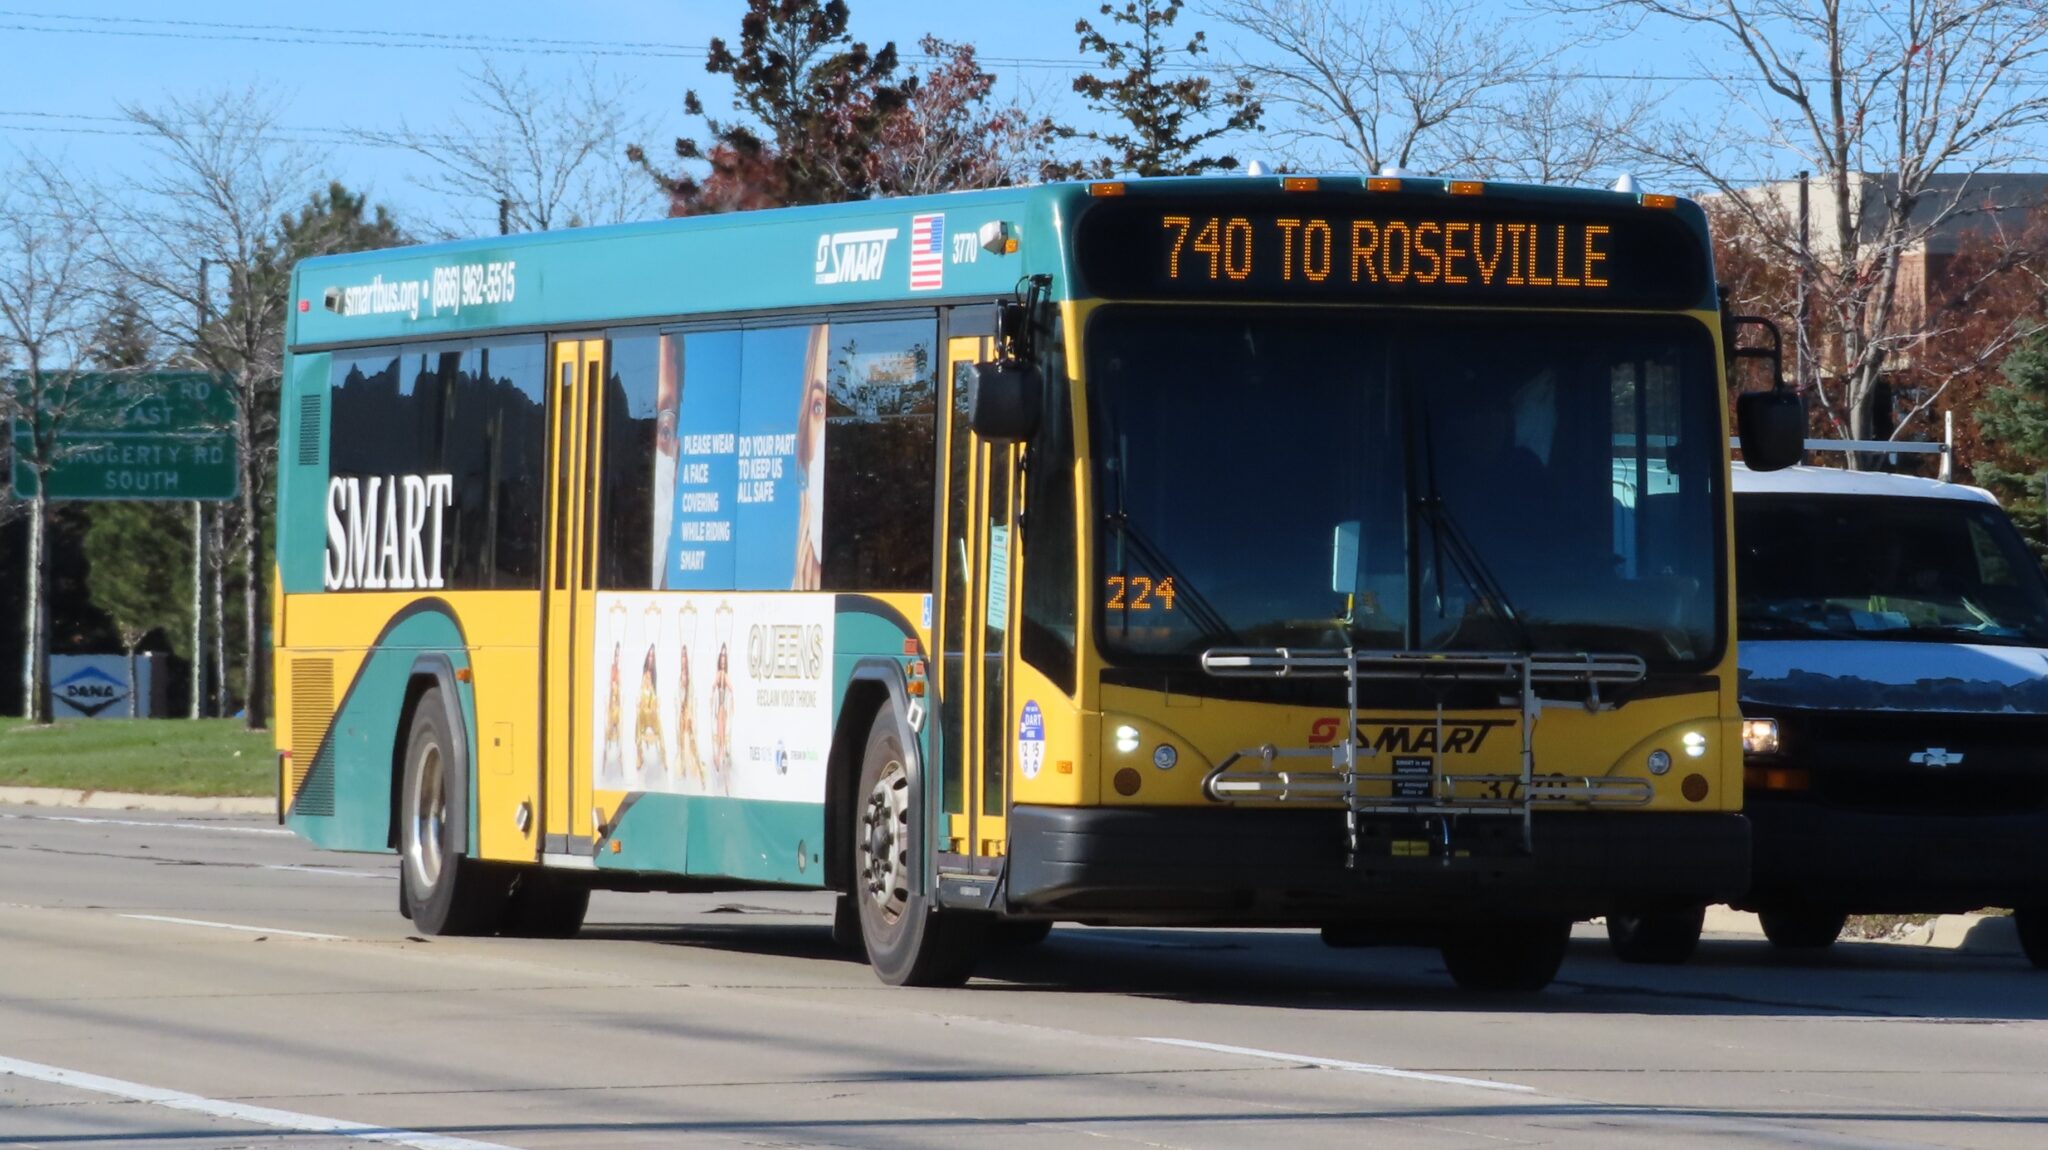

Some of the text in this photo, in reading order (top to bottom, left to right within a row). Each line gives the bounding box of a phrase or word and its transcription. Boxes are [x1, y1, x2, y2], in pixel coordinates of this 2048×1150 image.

[816, 228, 898, 284] SMART
[953, 232, 977, 264] 3770
[1163, 216, 1610, 287] 740 TO ROSEVILLE
[344, 261, 515, 320] smartbus.org (866) 962-5515
[194, 446, 223, 464] RD
[684, 433, 734, 455] PLEASE WEAR
[739, 434, 796, 457] DO YOUR PART
[683, 463, 709, 484] A FACE
[739, 458, 783, 480] TO KEEP US
[105, 471, 178, 490] SOUTH
[737, 480, 774, 503] ALL SAFE
[682, 492, 719, 512] COVERING
[324, 474, 453, 590] SMART
[681, 521, 730, 541] WHILE RIDING
[680, 550, 705, 570] SMART
[1107, 576, 1175, 610] 224
[748, 623, 824, 681] QUEENS
[1025, 713, 1042, 726] DART
